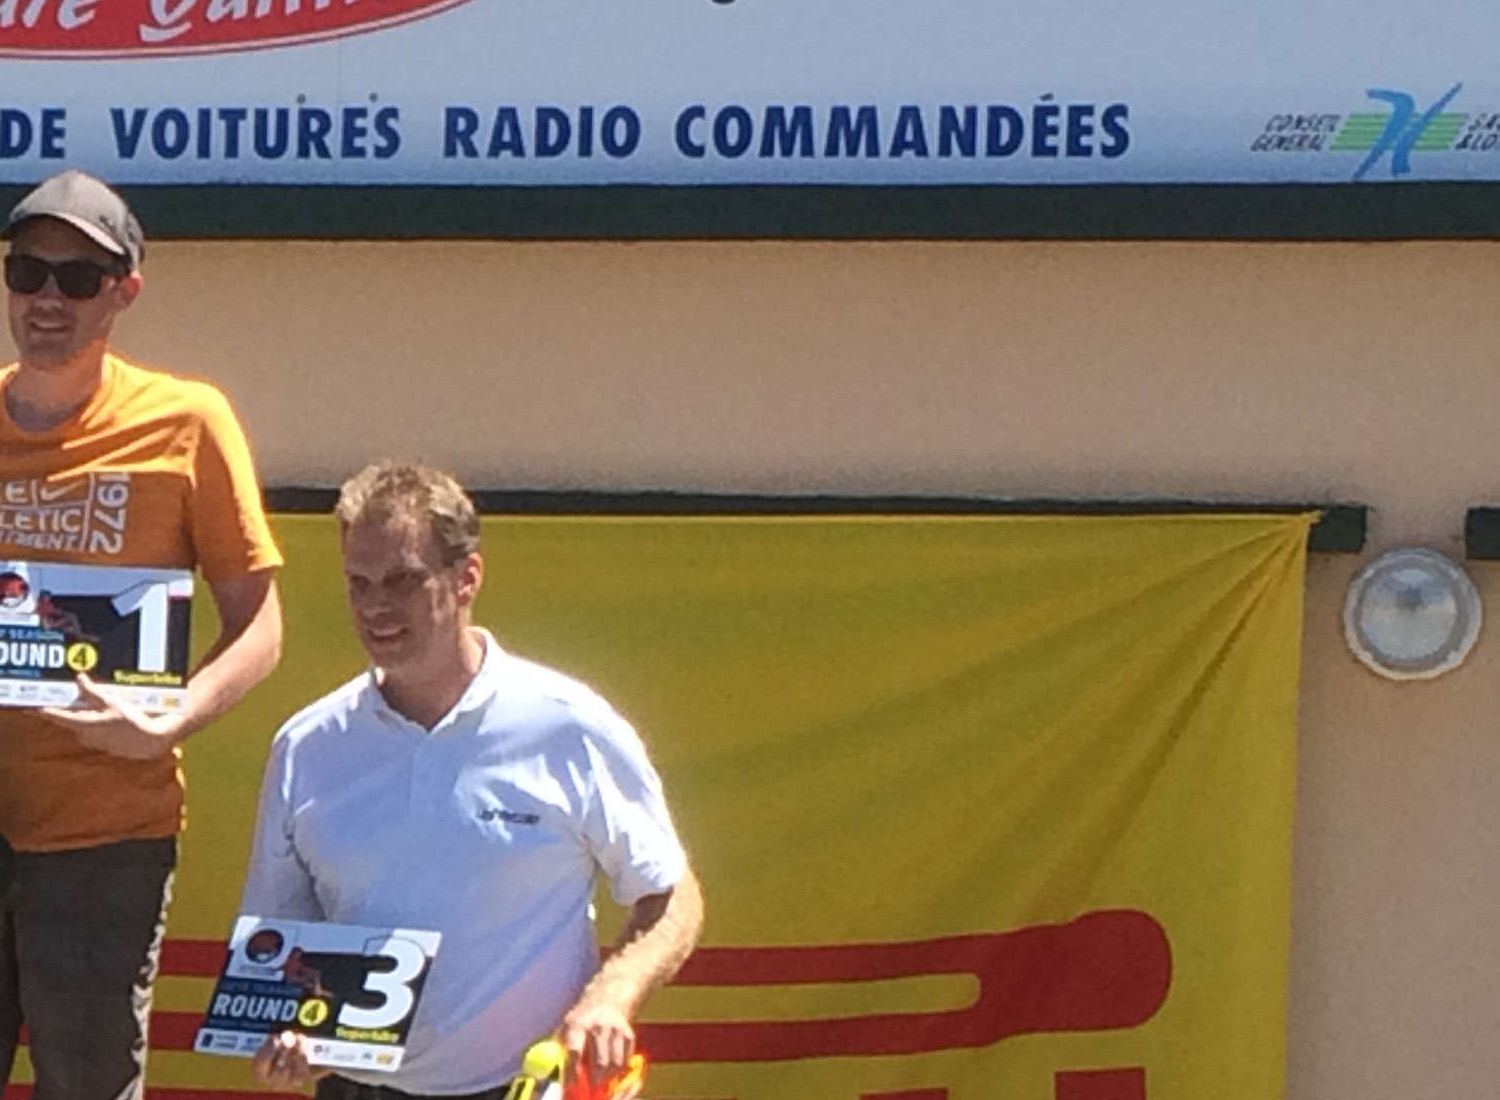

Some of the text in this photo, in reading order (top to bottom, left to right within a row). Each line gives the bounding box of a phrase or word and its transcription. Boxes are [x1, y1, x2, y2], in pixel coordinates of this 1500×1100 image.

[110, 106, 402, 161] VOITURES
[442, 105, 642, 158] RADIO
[674, 93, 1131, 158] COMMANDÉES
[110, 579, 169, 673] 1
[212, 993, 299, 1023] ROUND
[336, 936, 426, 1030] 3
